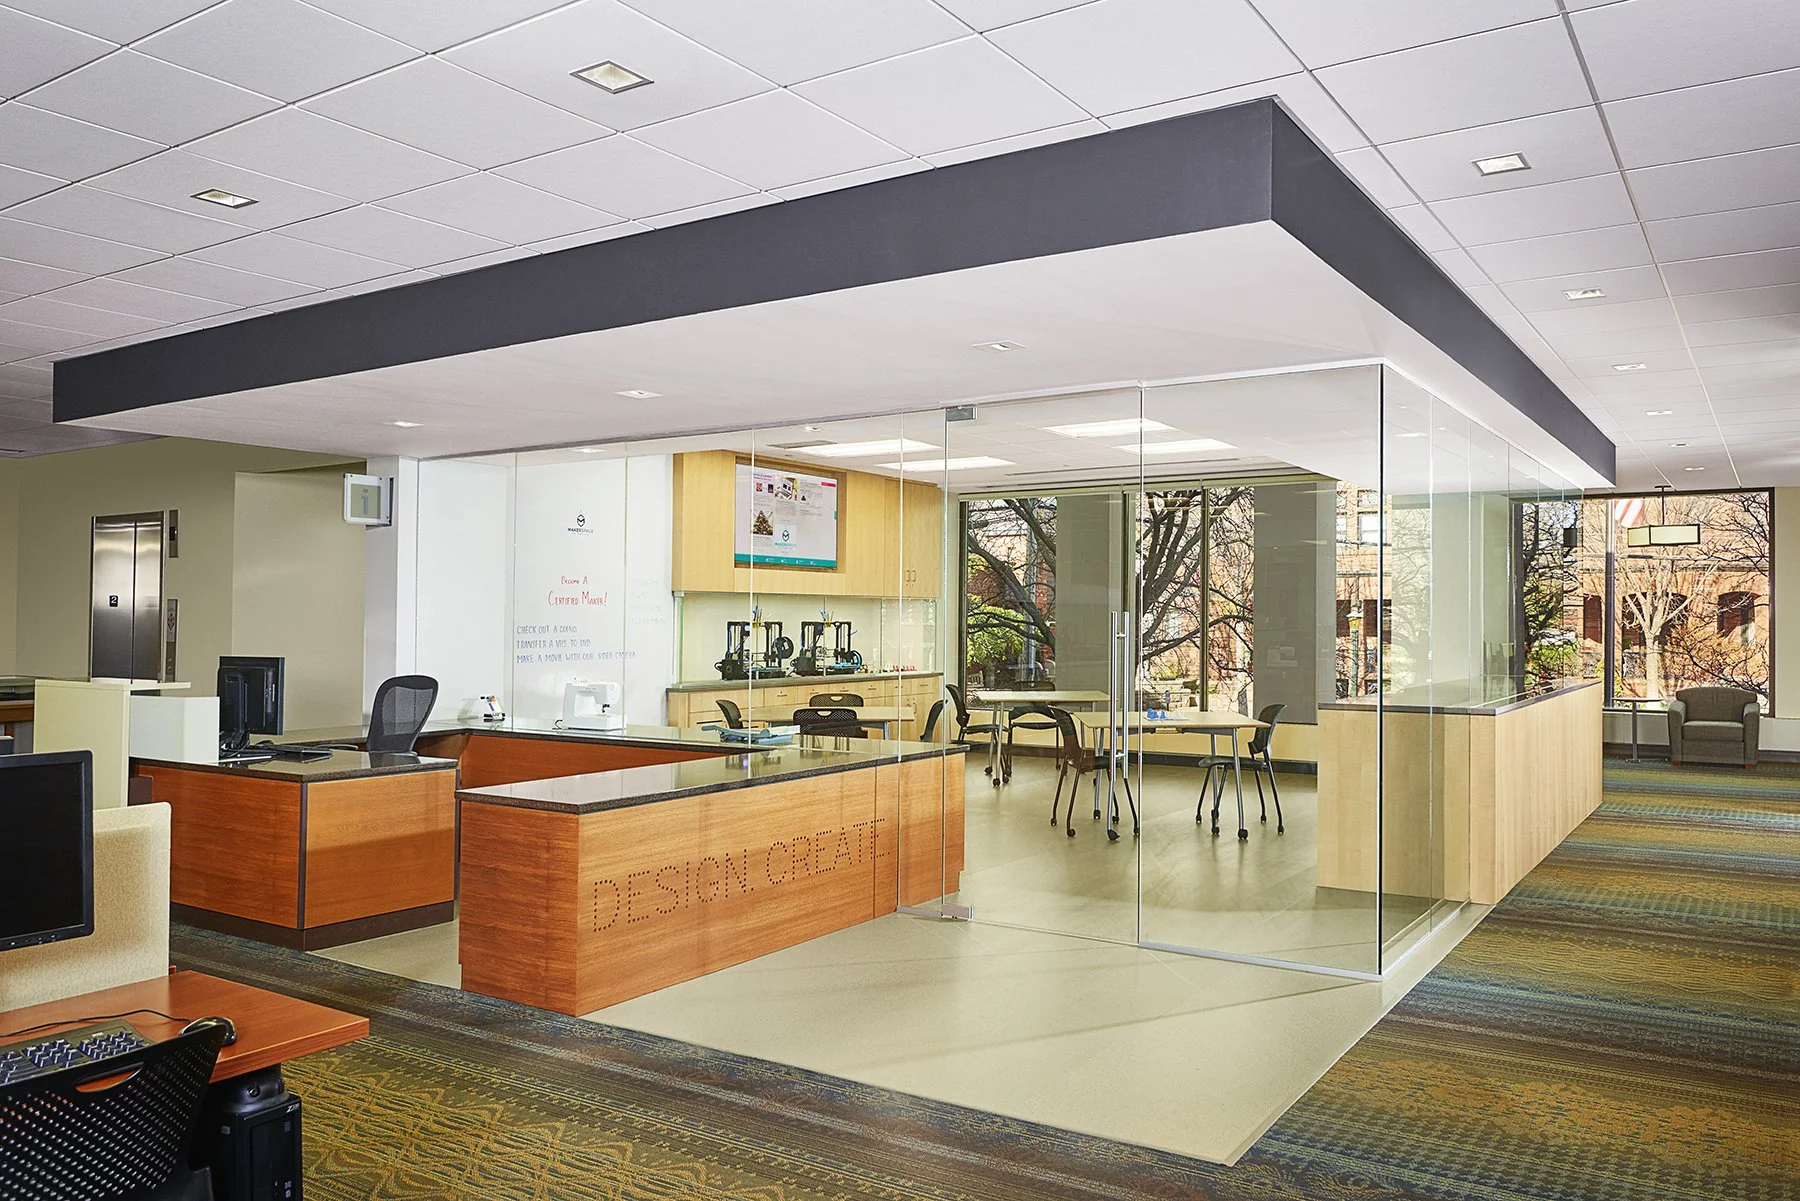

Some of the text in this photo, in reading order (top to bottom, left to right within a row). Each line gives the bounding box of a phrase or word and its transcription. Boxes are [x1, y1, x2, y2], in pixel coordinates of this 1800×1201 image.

[582, 575, 588, 585] A
[516, 625, 537, 635] CHECK
[538, 625, 550, 634] OUT
[553, 625, 558, 634] A
[516, 639, 547, 649] TRANSFER
[548, 639, 554, 648] A
[555, 639, 567, 648] VHS
[570, 639, 578, 647] TO
[516, 653, 535, 664] MAKE
[537, 653, 543, 663] A
[545, 652, 563, 662] MOVIE
[564, 651, 581, 661] WITH
[592, 848, 755, 933] DESIGN.
